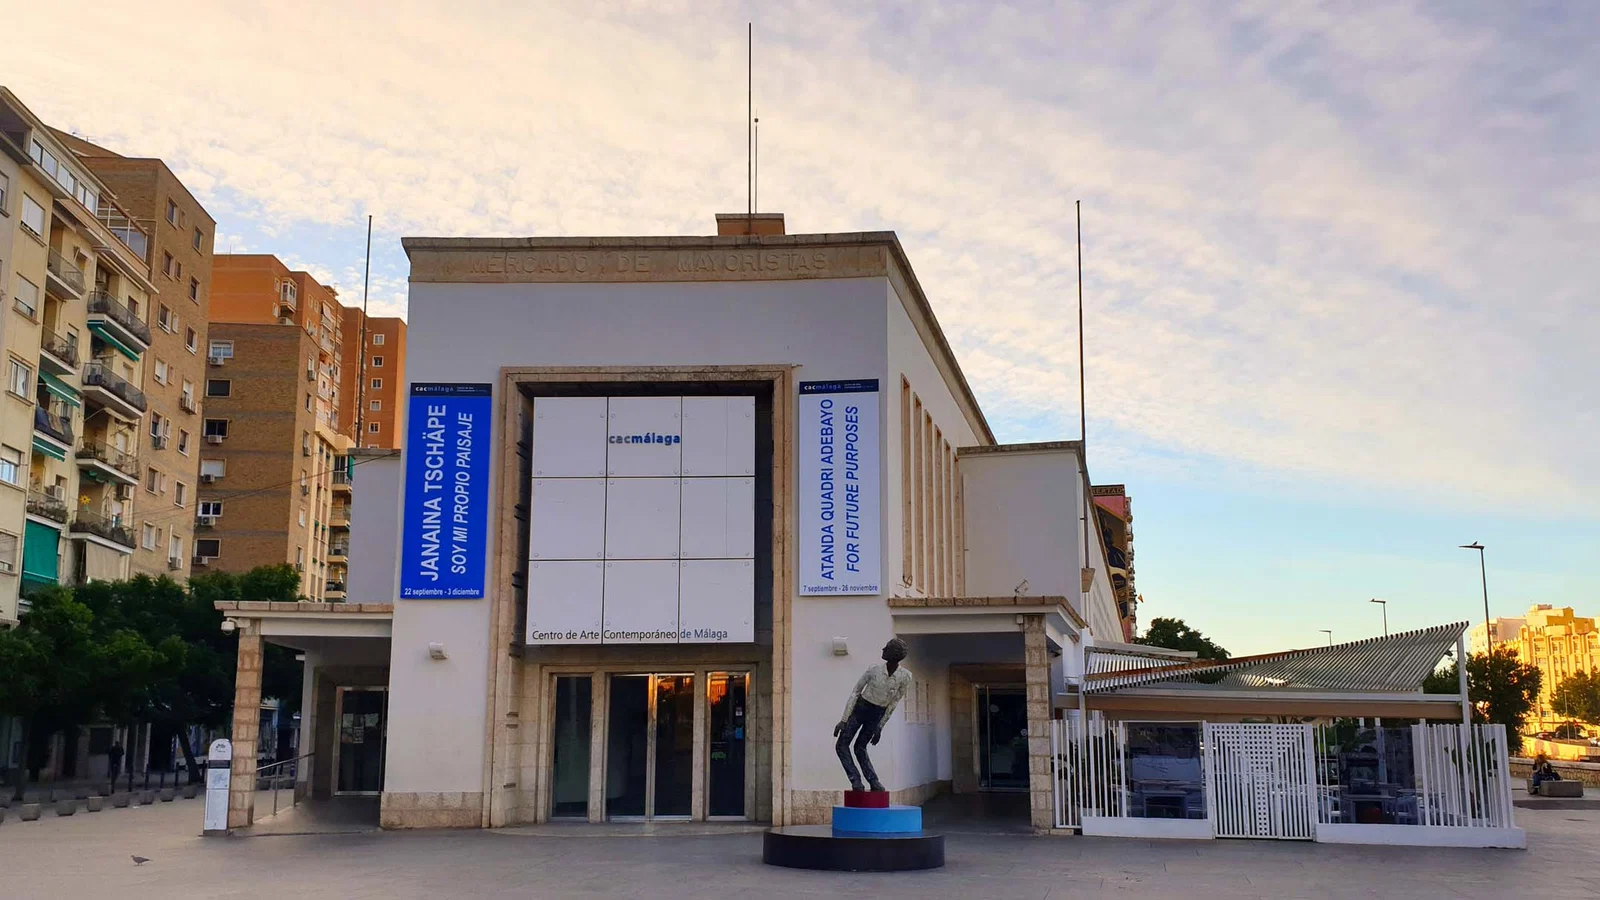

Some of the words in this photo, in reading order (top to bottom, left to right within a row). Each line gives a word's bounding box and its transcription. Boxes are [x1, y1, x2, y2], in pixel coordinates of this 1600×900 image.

[469, 254, 589, 274] MERCADO
[617, 254, 650, 273] DE
[676, 252, 827, 273] MAYORISTAS
[422, 405, 446, 493] TSCHÄPE
[456, 412, 473, 468] PAISAJE
[608, 432, 681, 446] cacmálaga
[820, 399, 834, 465] ADEBAYO
[845, 405, 859, 480] PURPOSES
[453, 471, 470, 524] PROPIO
[820, 468, 834, 521] QUADRI
[846, 484, 859, 539] FUTURE
[420, 497, 442, 581] JANAINA
[451, 544, 467, 574] SOY
[452, 526, 468, 542] MI
[820, 524, 834, 580] ATANDA
[846, 543, 860, 572] FOR
[404, 587, 412, 596] 22
[412, 587, 443, 597] septiembre
[447, 587, 452, 595] 3
[452, 587, 480, 596] diciembre
[808, 584, 838, 593] septiembre
[842, 584, 848, 592] 26
[849, 584, 878, 592] noviembre
[532, 630, 563, 640] Centro
[565, 630, 577, 640] de
[579, 630, 600, 640] Arte
[603, 629, 677, 641] Contemporáneo
[680, 629, 692, 639] de
[694, 629, 728, 640] Málaga
